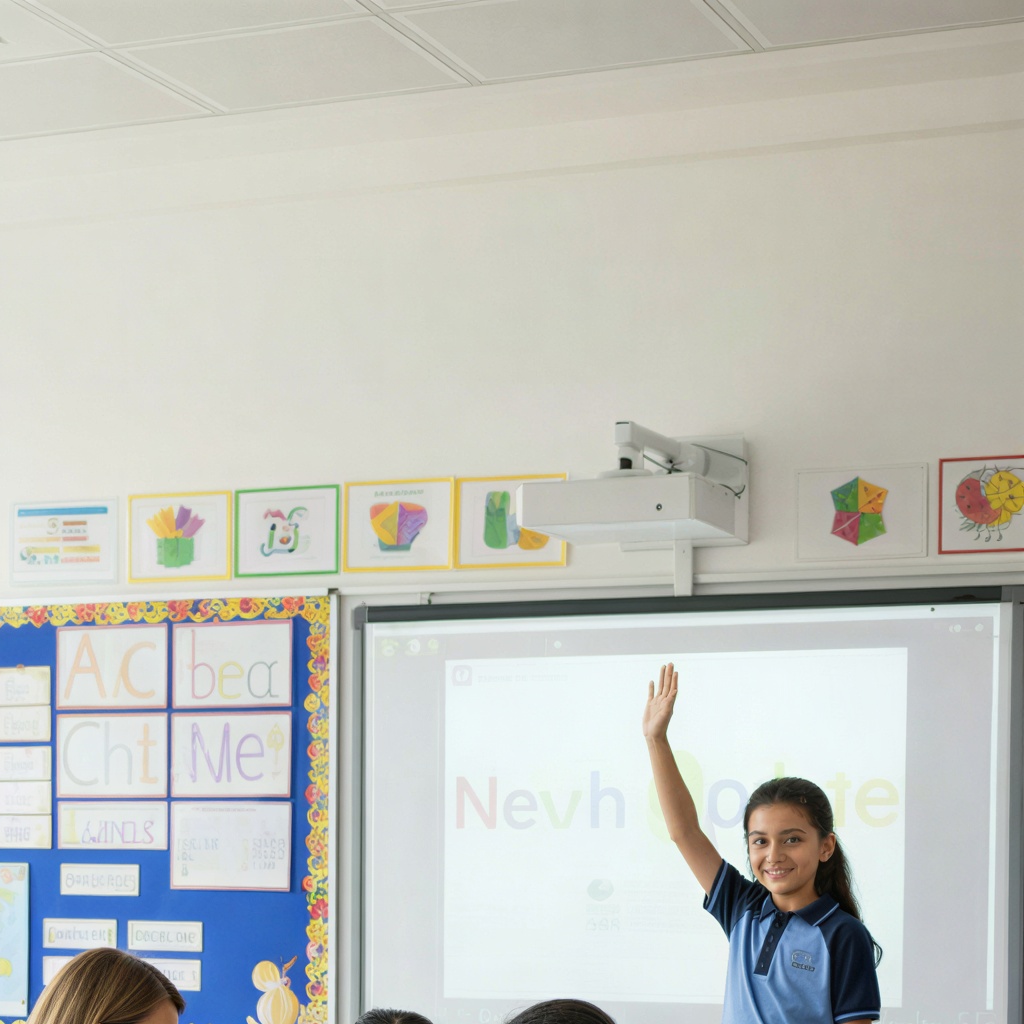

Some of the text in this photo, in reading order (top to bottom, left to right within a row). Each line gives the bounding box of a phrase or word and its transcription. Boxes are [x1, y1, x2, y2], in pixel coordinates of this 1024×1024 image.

[189, 629, 279, 699] bea
[62, 720, 159, 786] Cht
[455, 770, 626, 830] Nevh
